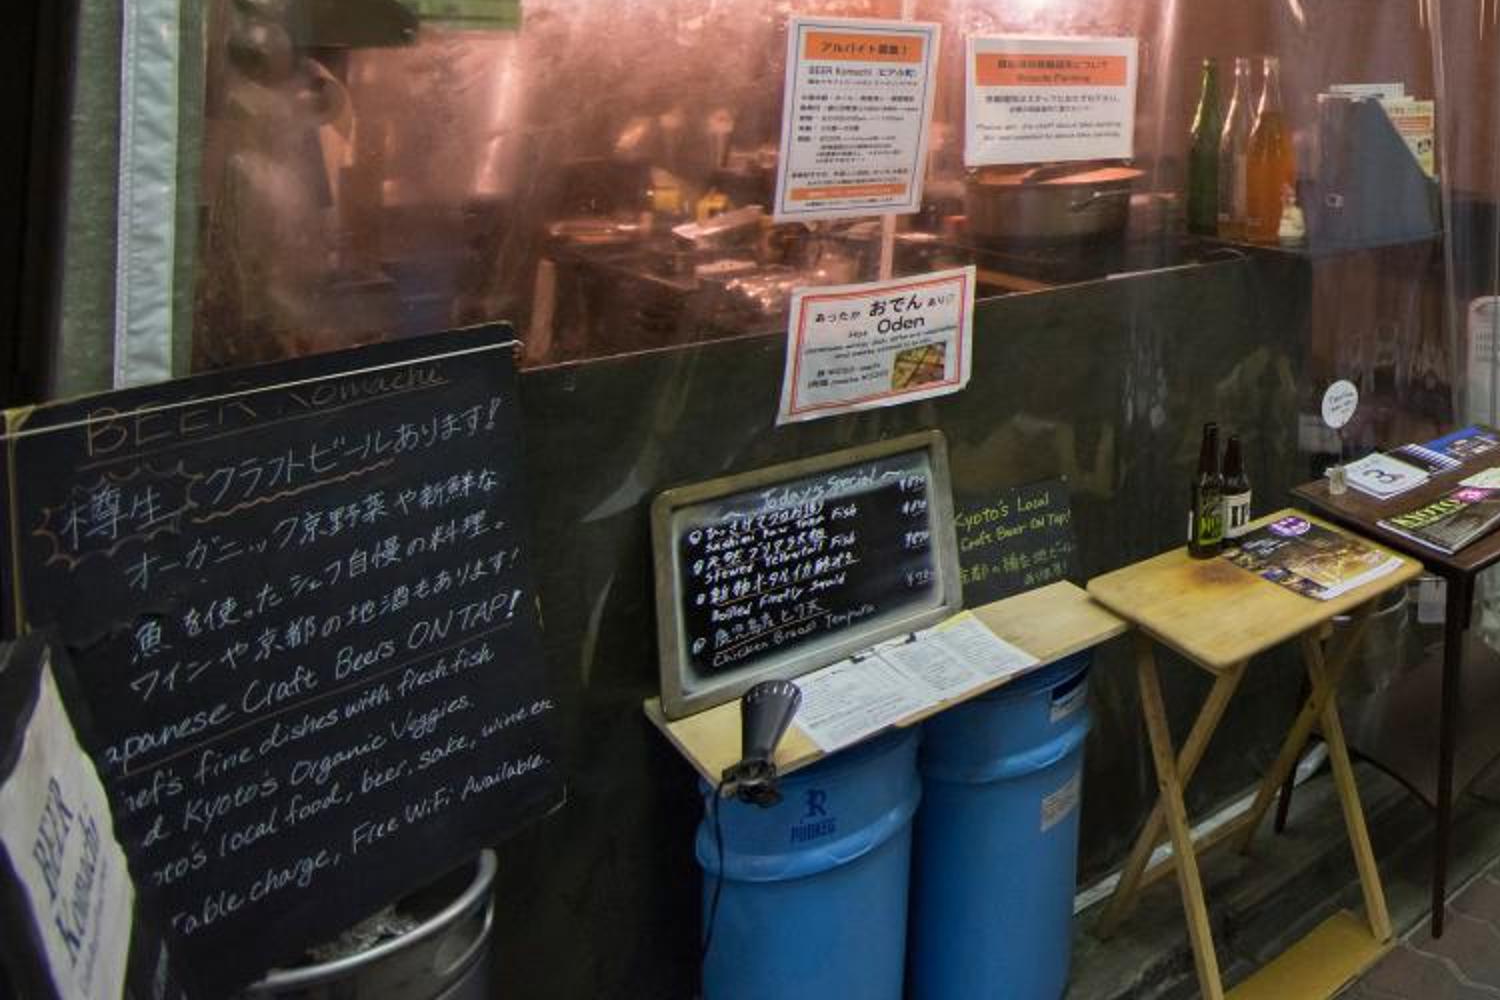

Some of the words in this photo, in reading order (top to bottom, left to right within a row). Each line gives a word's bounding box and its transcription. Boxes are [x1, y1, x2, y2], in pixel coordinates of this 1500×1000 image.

[869, 293, 922, 317] おでん
[877, 317, 925, 334] Oden
[105, 704, 236, 775] apanese
[242, 664, 319, 713] Craft
[334, 640, 397, 680] Beers
[259, 708, 339, 755] dishes
[345, 683, 391, 718] with
[398, 659, 449, 697] fresh
[450, 643, 495, 673] fish
[291, 733, 387, 786] Organic
[221, 807, 278, 857] local
[352, 816, 399, 854] Free
